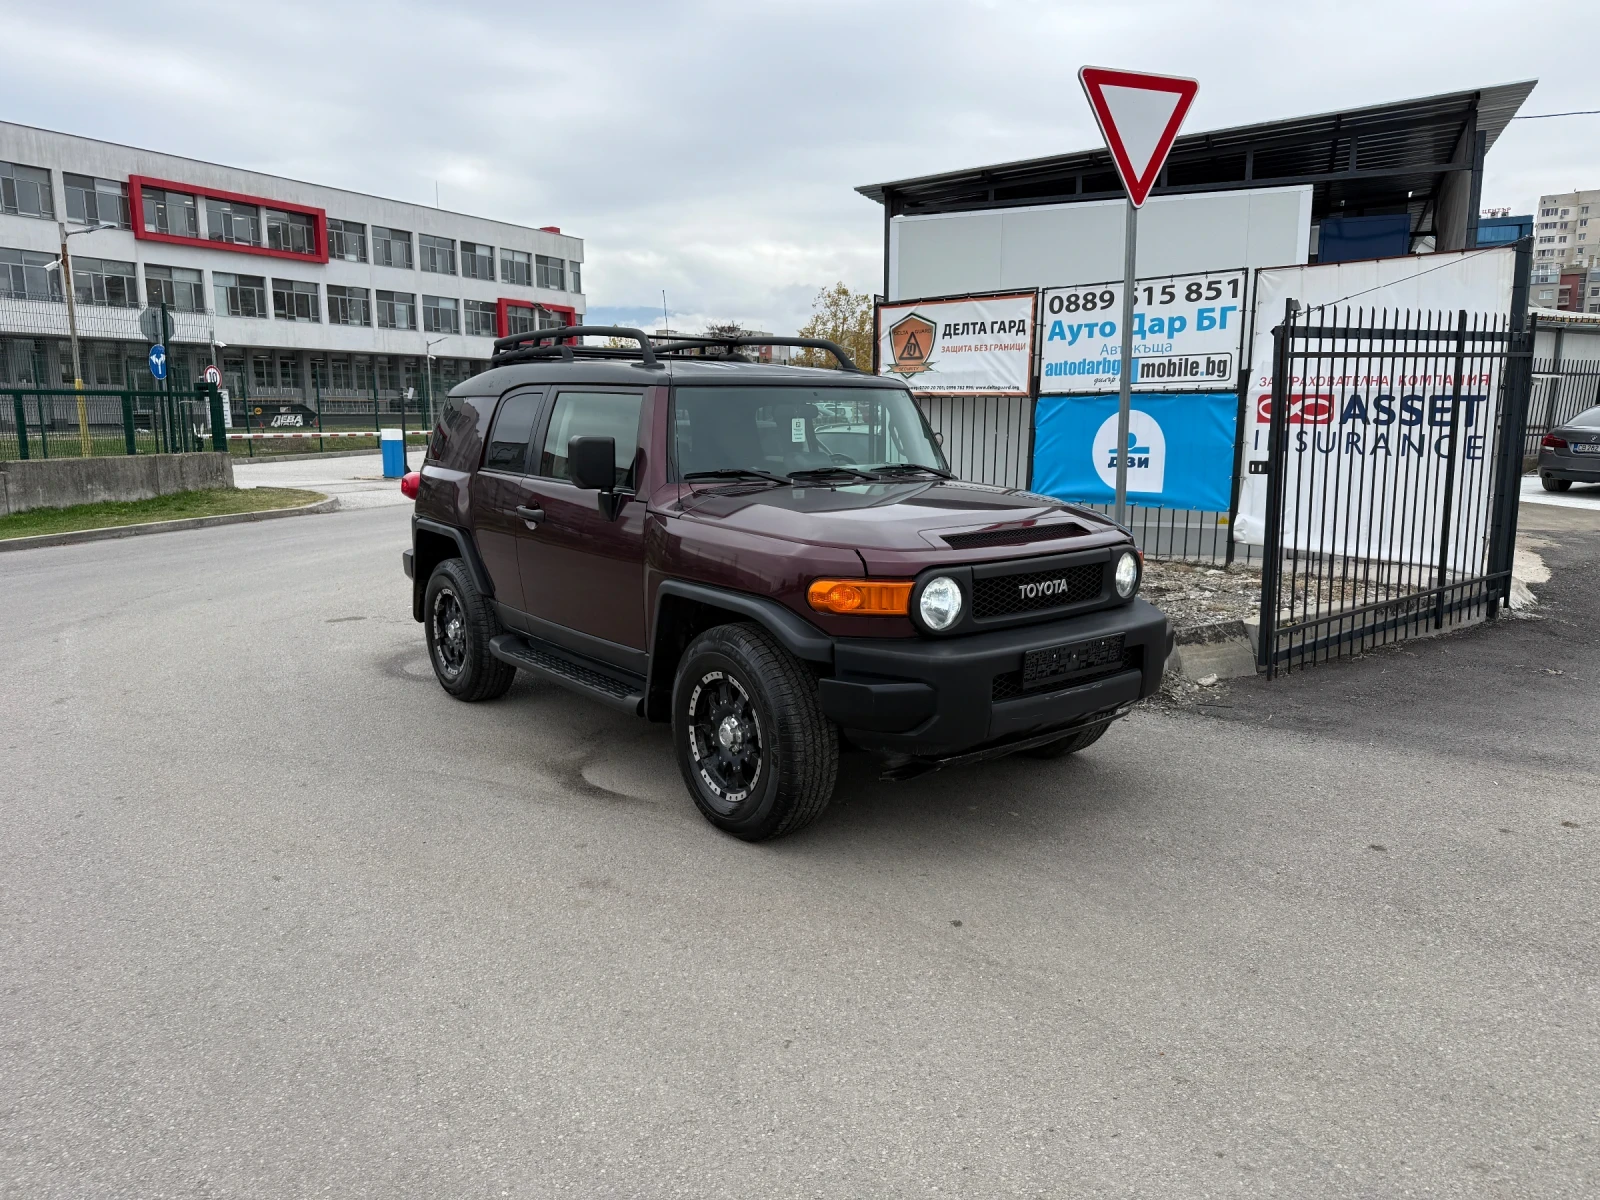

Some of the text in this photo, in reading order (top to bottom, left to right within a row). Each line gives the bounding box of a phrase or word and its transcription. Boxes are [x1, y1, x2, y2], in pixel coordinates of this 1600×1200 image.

[1048, 290, 1115, 315] 0889
[1184, 278, 1240, 303] 851
[942, 318, 1026, 340] ДЕЛТА ГАРД
[1047, 305, 1238, 347] Ауто Дар БГ
[941, 342, 1026, 355] ЗАЩИТА БЕЗ ГРАНИЦИ
[1099, 342, 1173, 356] Авткъща
[208, 371, 217, 383] 10
[1140, 356, 1228, 379] mobile.bg
[1338, 394, 1487, 427] ASSET
[1018, 578, 1069, 599] TOYOTA
